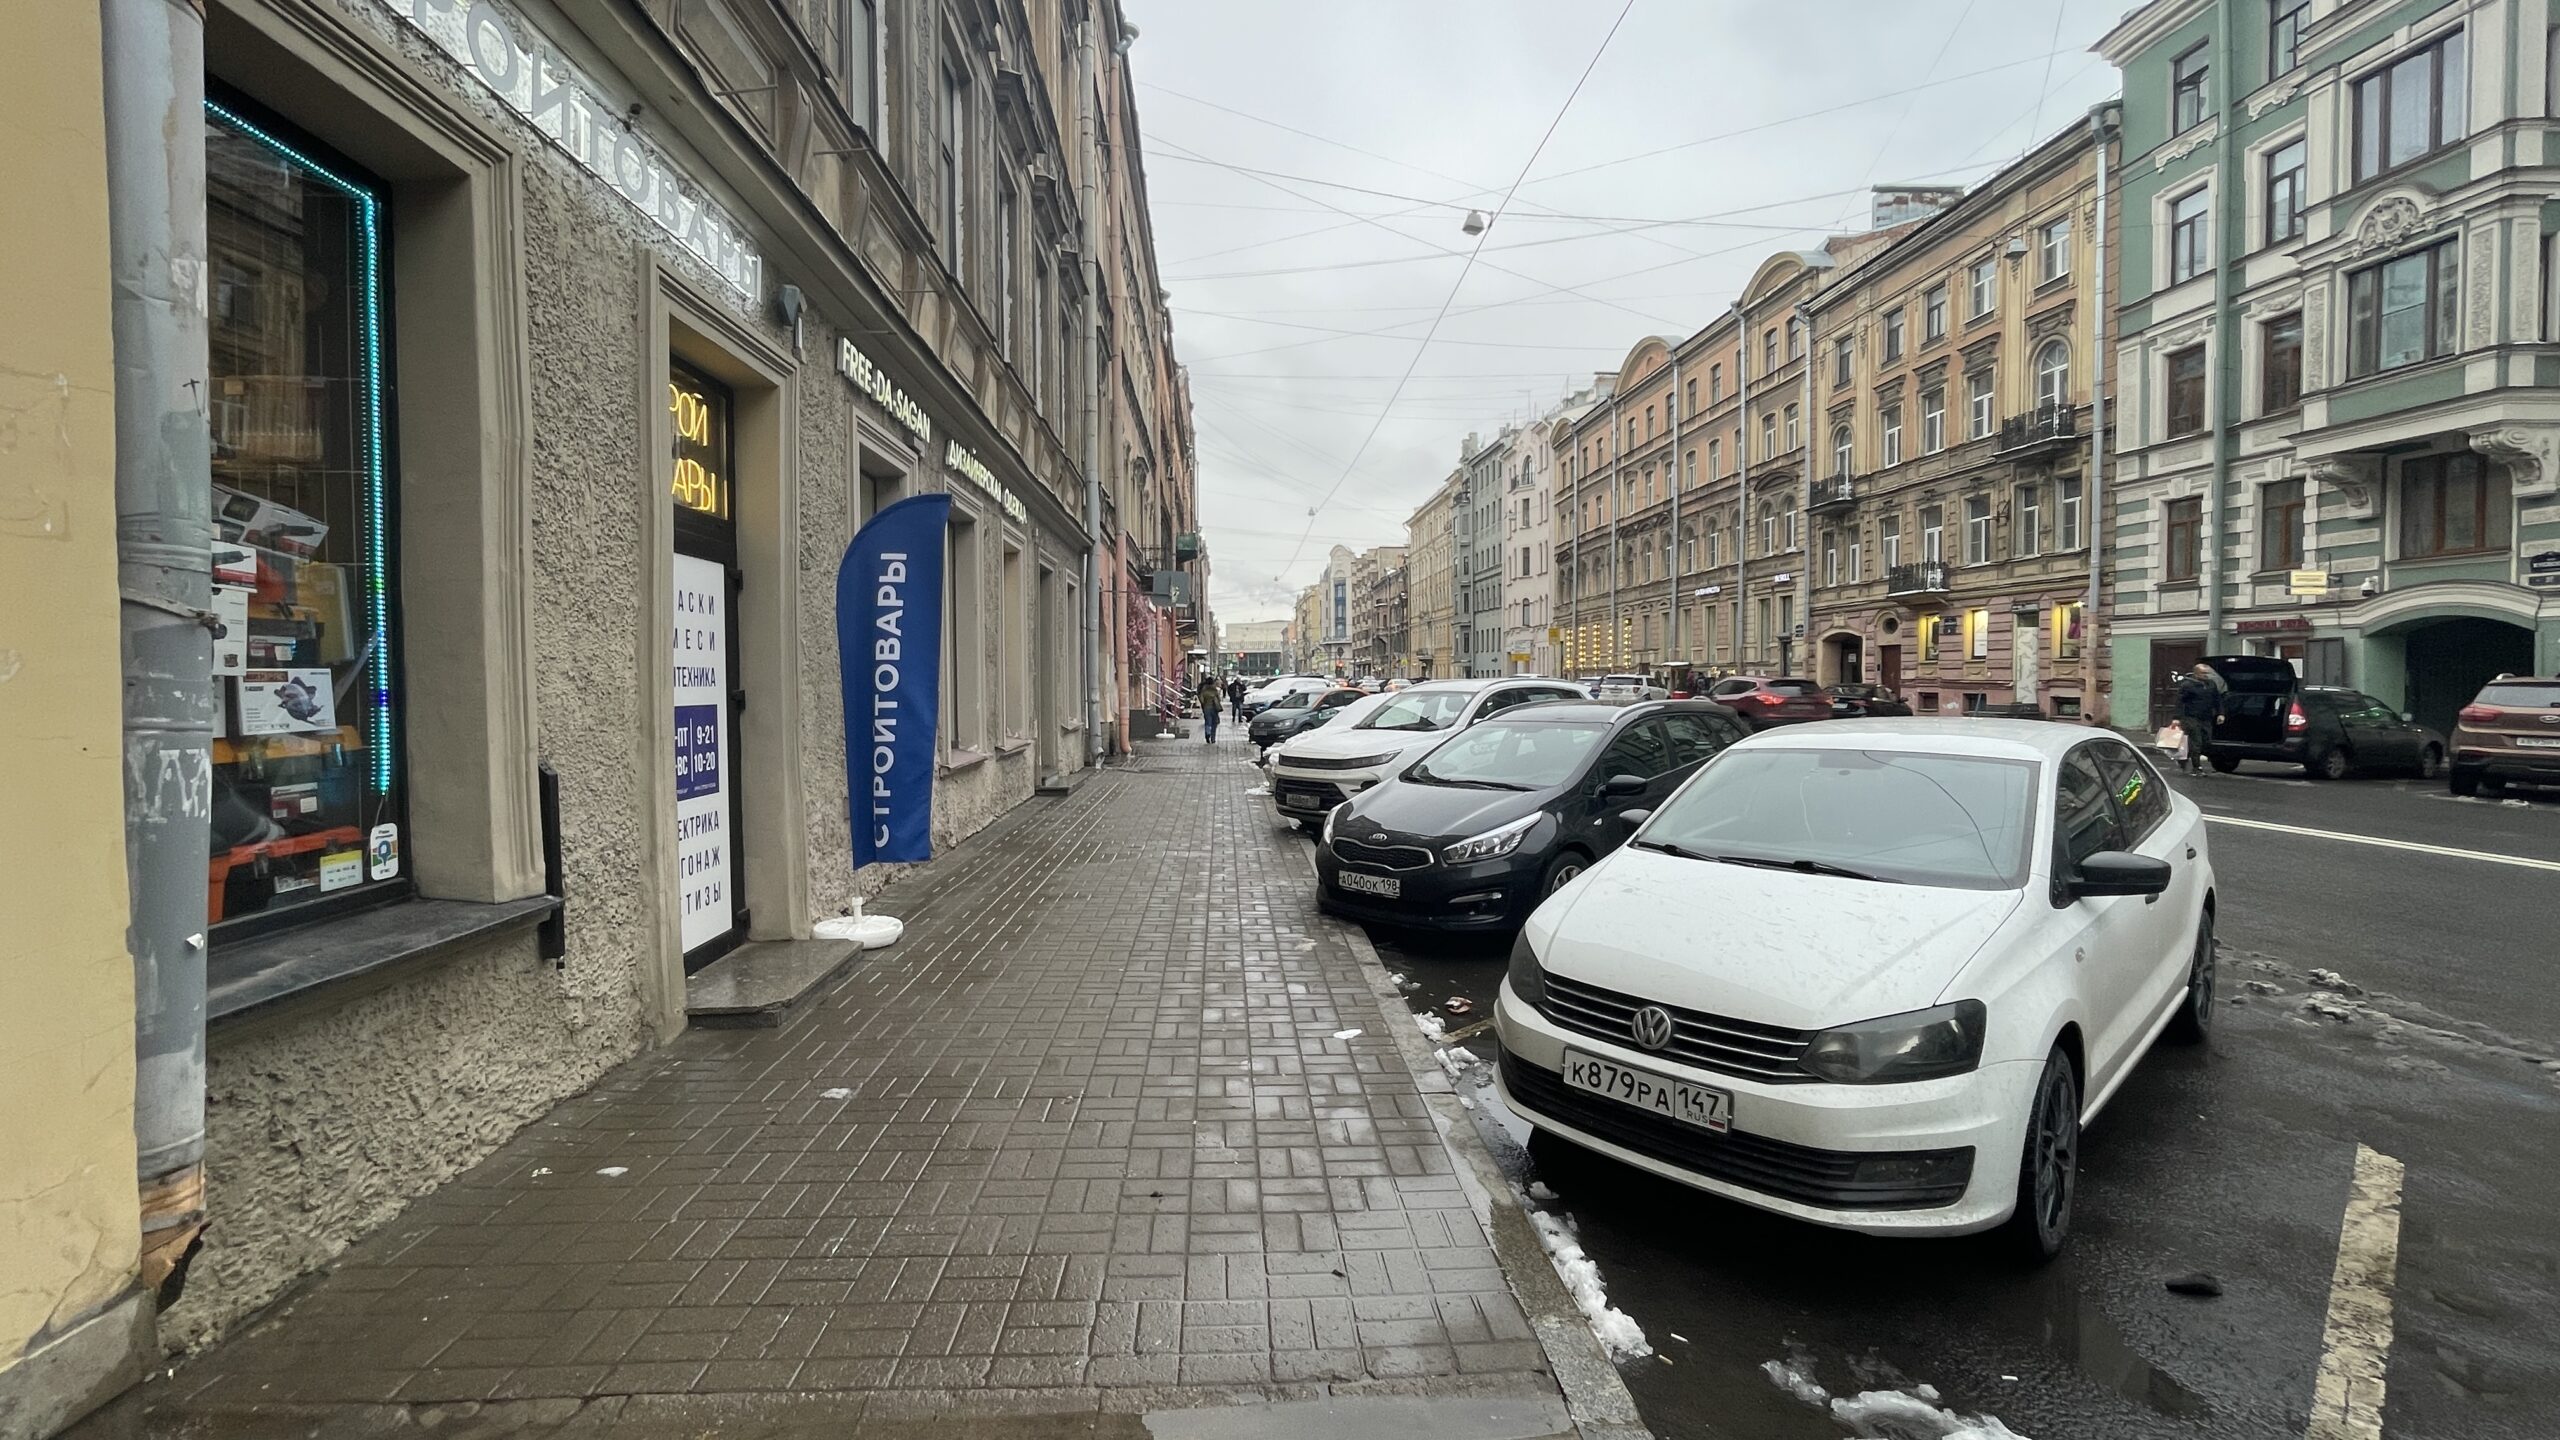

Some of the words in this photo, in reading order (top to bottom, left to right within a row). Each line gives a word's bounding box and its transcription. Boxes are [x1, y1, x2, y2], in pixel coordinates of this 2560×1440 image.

[411, 0, 762, 301] ОЙТОВАРЫ
[696, 724, 715, 746] 9-21
[693, 751, 716, 774] 10-20
[680, 880, 722, 916] ТИЗЫ
[1677, 1086, 1721, 1117] 147
[1685, 1110, 1709, 1125] RUS
